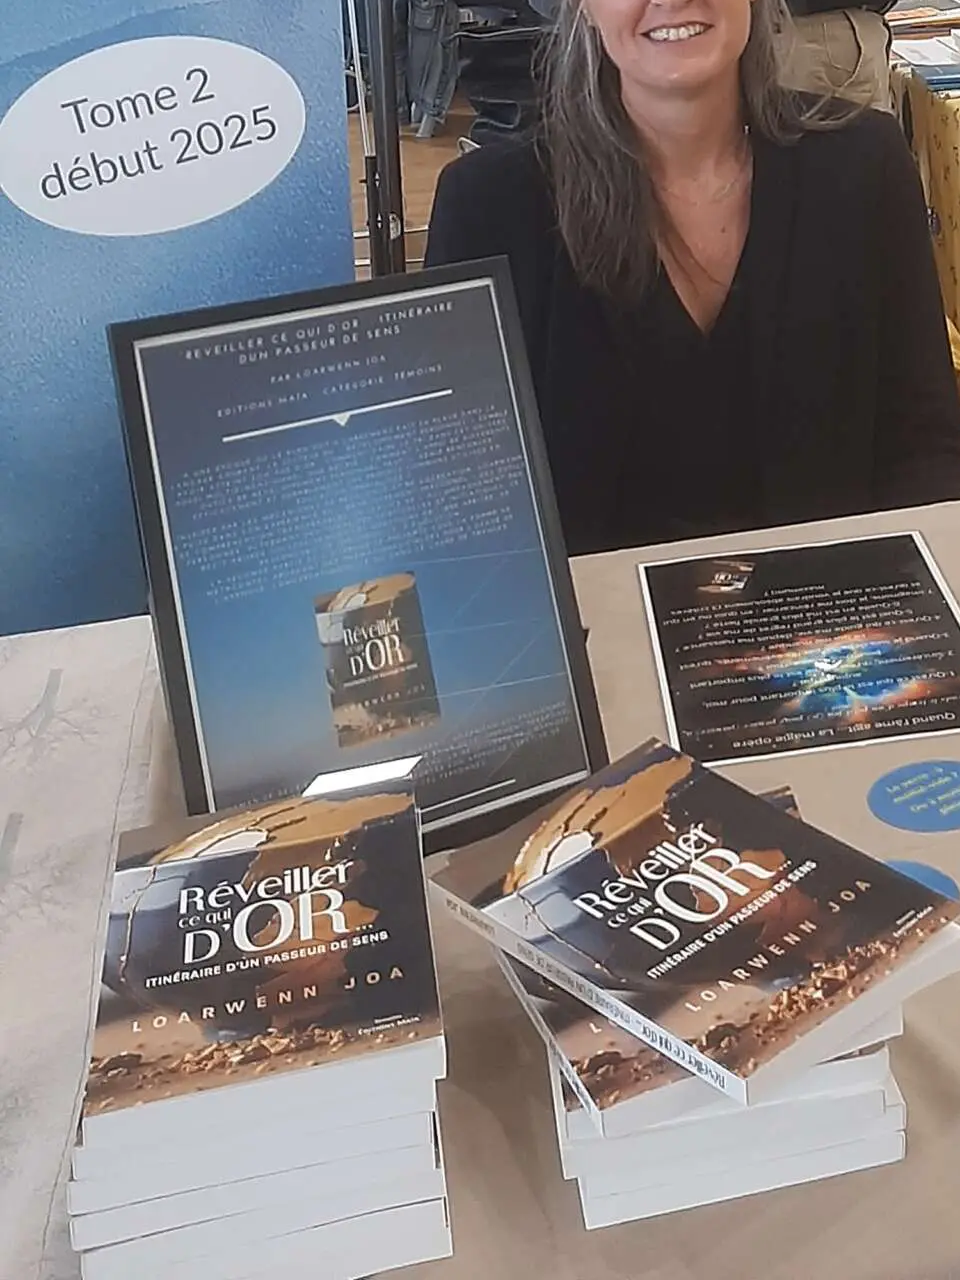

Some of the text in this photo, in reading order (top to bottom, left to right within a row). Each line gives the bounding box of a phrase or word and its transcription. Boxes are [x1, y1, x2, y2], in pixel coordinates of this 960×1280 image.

[61, 68, 215, 134] Tome 2
[41, 105, 277, 199] début 2025
[271, 332, 287, 343] CE
[295, 326, 320, 339] QUI
[275, 337, 335, 355] PASSEUR
[342, 332, 357, 344] DE
[366, 324, 400, 338] SENS
[732, 737, 771, 747] opère
[818, 728, 834, 736] La
[911, 712, 955, 724] Quand
[178, 859, 354, 916] Réveiller
[572, 822, 717, 919] Réveiller
[178, 905, 232, 930] ce qui
[606, 896, 654, 929] ce qui
[646, 860, 818, 980] ITINÉRAIRE D'UN PASSEUR DE SENS
[145, 929, 388, 989] ITINÉRAIRE D'UN PASSEUR DE SENS
[684, 919, 818, 1013] LOARWENN
[827, 878, 873, 914] JOA
[131, 985, 317, 1033] LOARWENN
[344, 966, 404, 990] JOA
